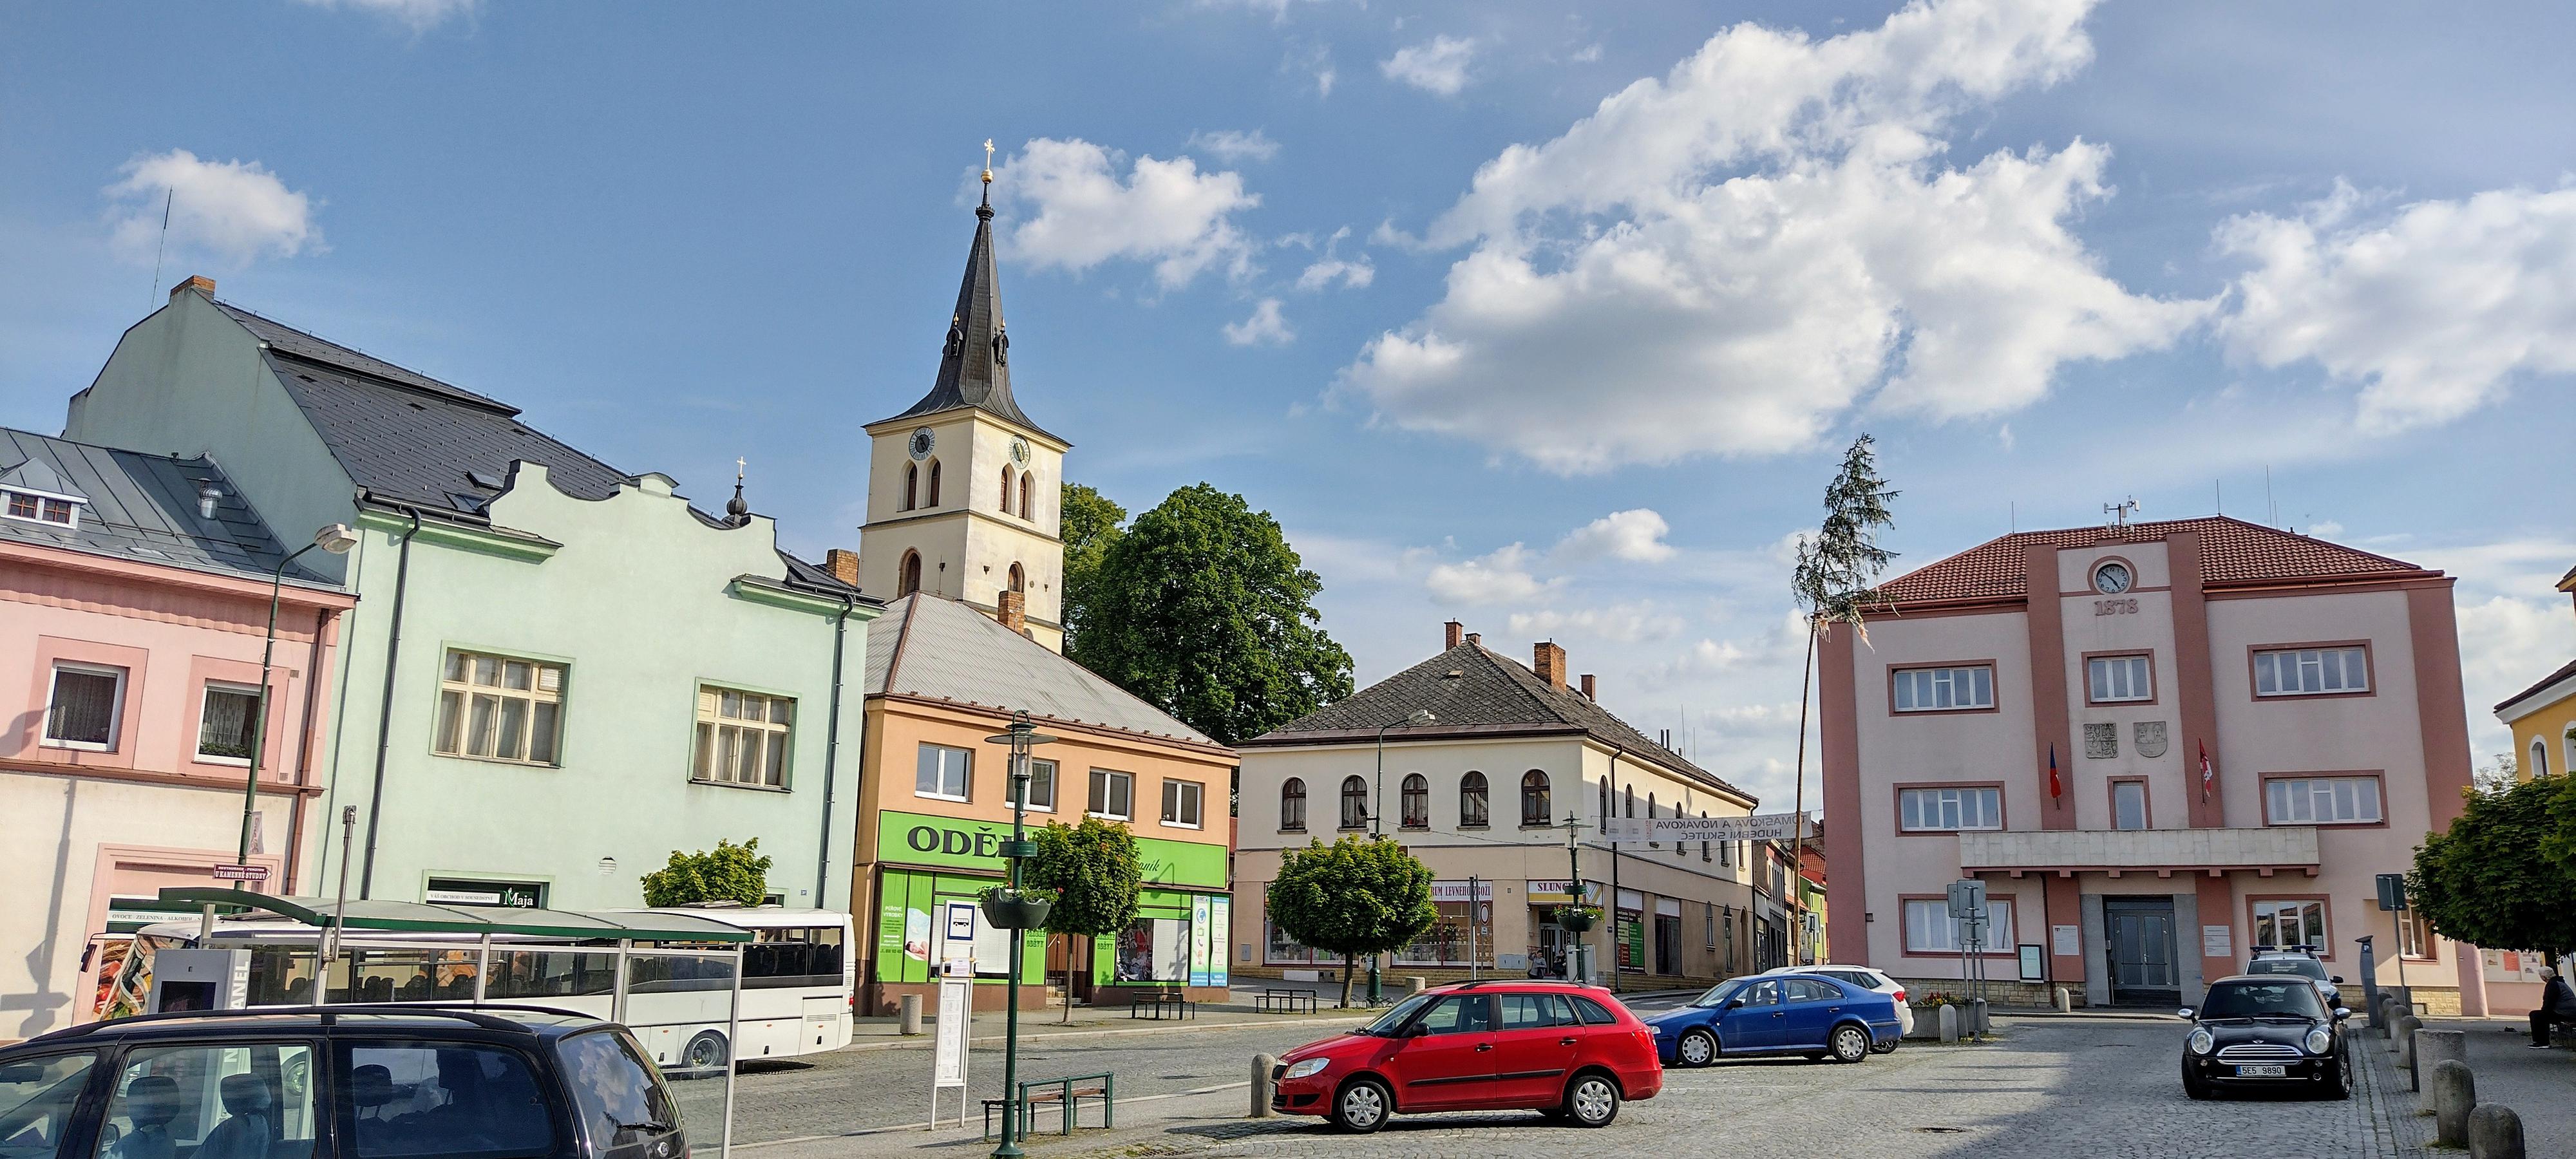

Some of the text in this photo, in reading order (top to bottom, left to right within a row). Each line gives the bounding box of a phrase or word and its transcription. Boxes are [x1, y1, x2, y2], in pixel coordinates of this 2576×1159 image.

[2094, 598, 2139, 616] 1878
[1431, 886, 1443, 896] RUM
[1538, 882, 1573, 891] SLUNC
[503, 891, 533, 907] Maja
[231, 961, 249, 1010] ANEL
